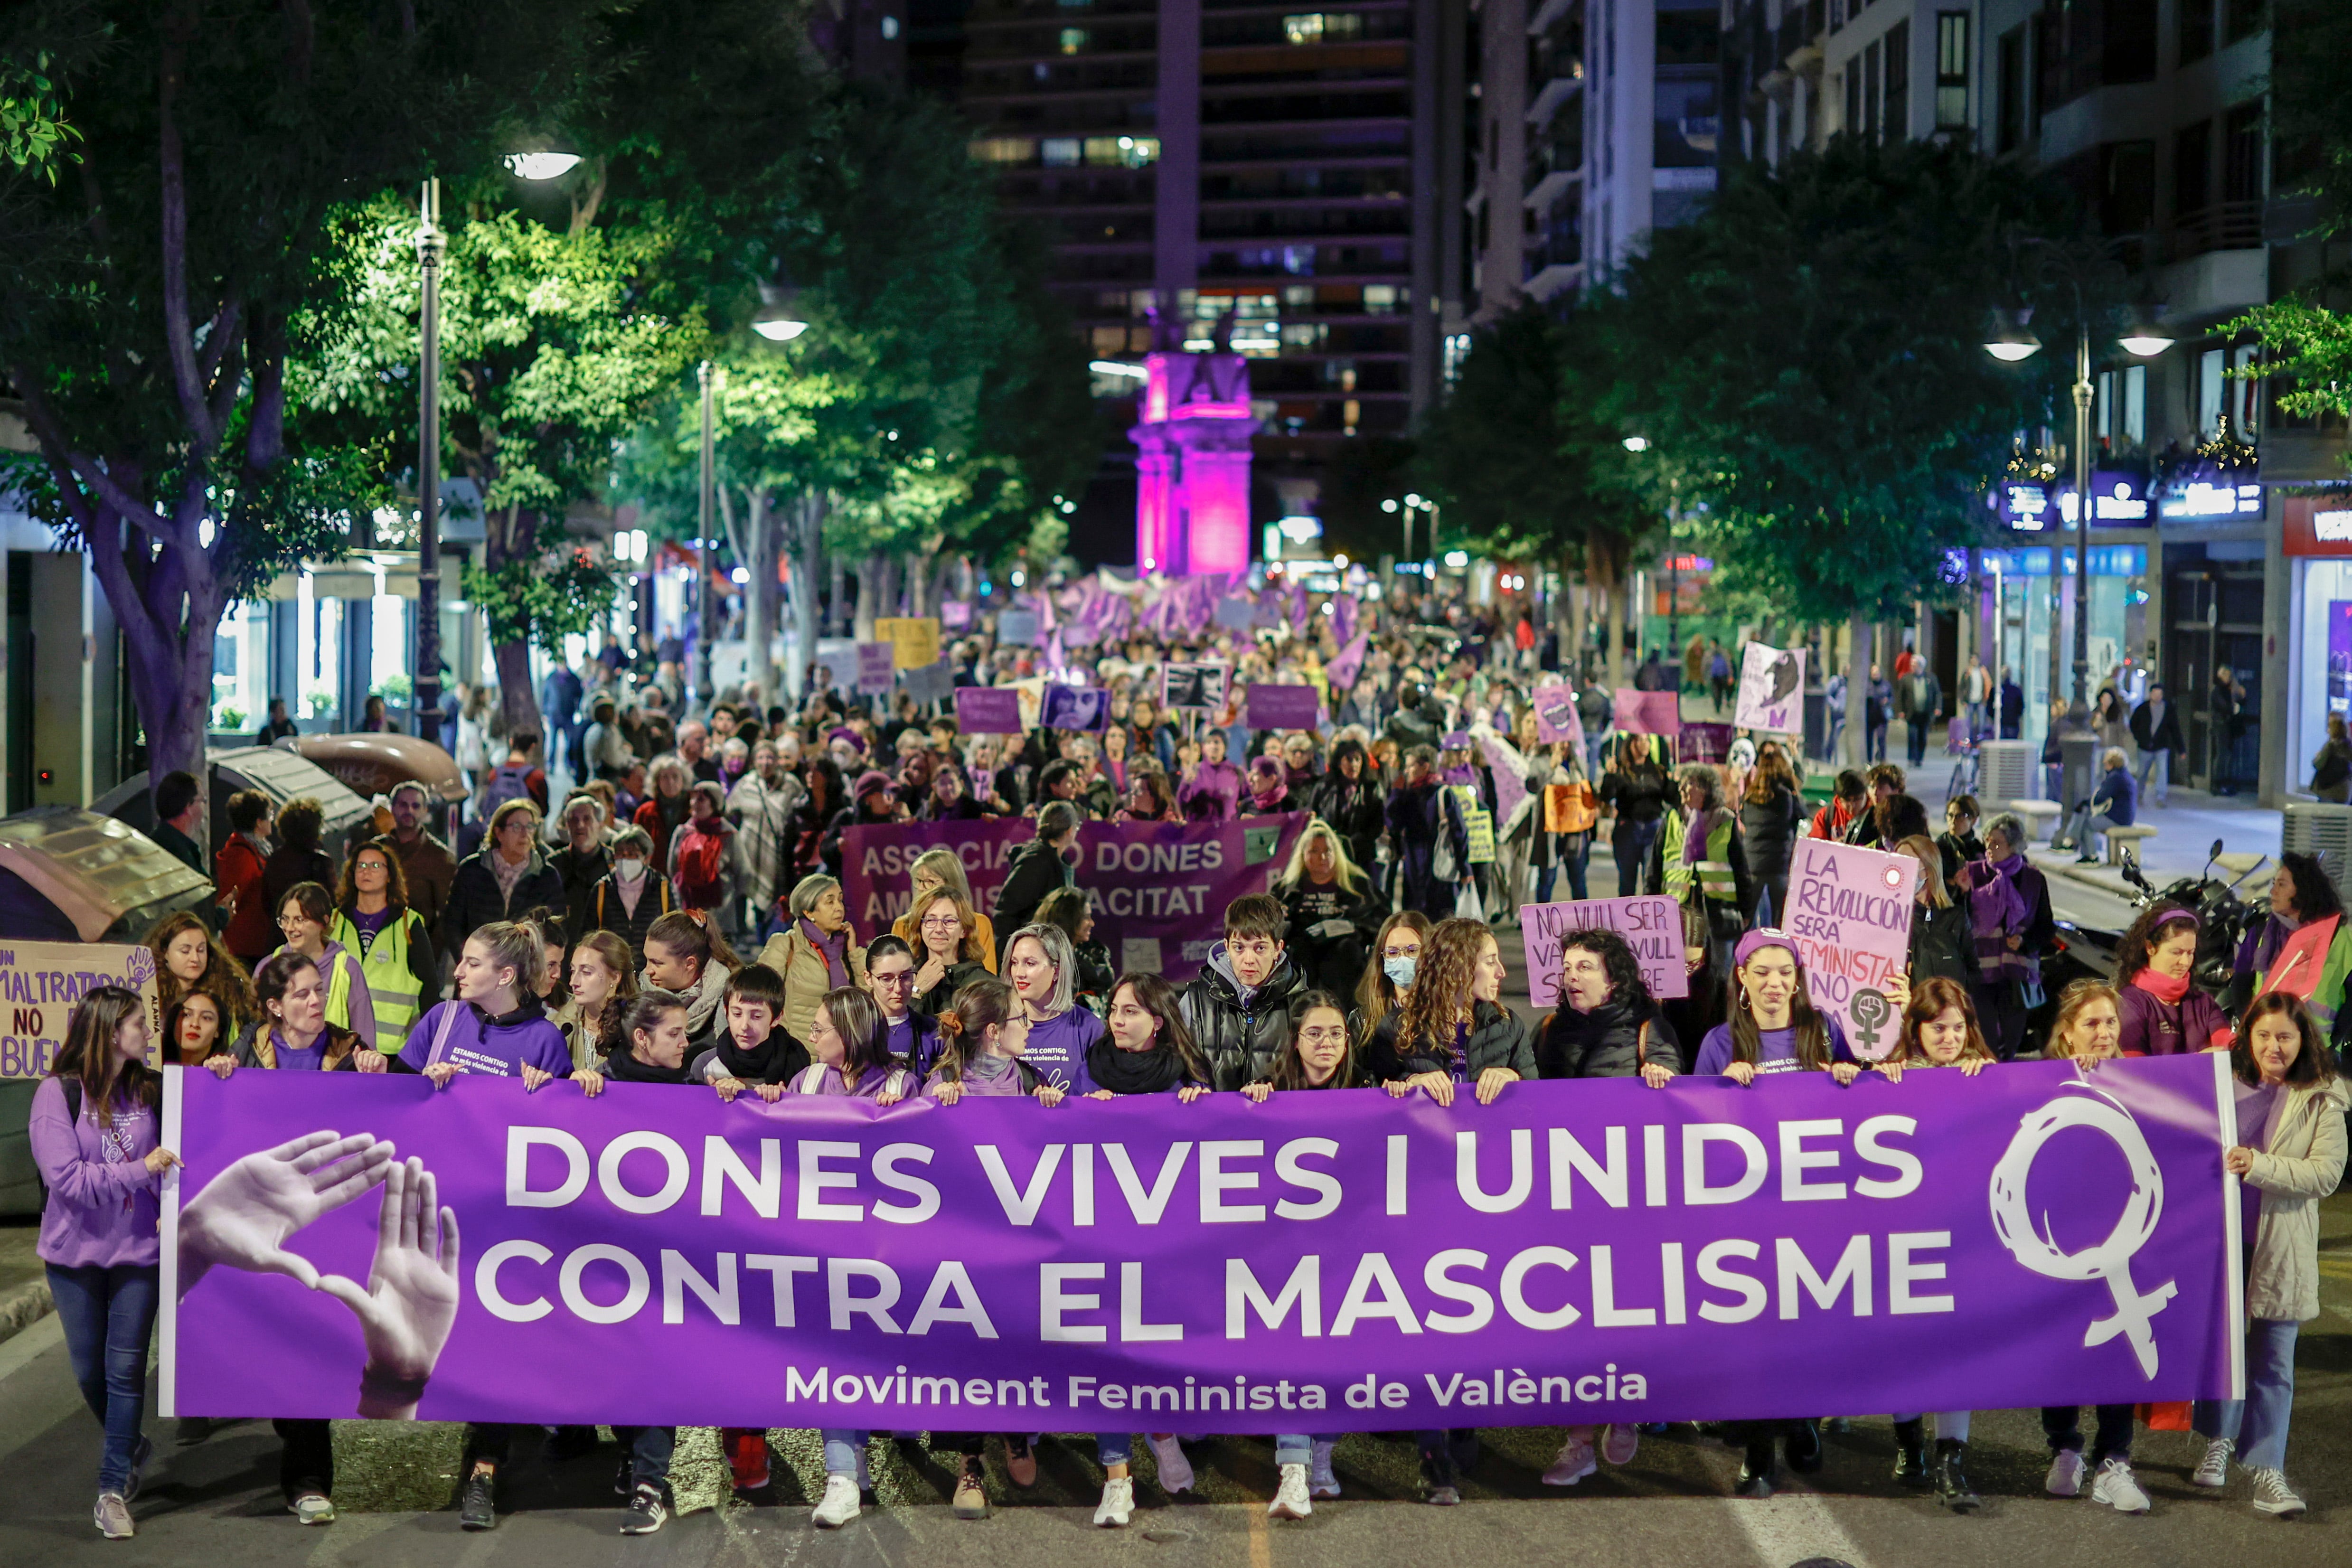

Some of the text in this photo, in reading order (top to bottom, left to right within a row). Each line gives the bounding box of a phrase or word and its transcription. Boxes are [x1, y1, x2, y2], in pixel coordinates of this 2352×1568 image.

[1096, 840, 1223, 873] DONES
[1805, 849, 1839, 882] LA
[1536, 907, 1563, 940] NO
[1625, 901, 1669, 931] SER
[1798, 878, 1910, 933] REVOLUCIÓN
[1793, 914, 1844, 943] SERÁ
[1630, 936, 1676, 960] VULL
[1812, 972, 1849, 1003] NO
[14, 1008, 43, 1037] NO
[452, 1047, 508, 1068] ESTAMOS CONTIGO
[472, 1061, 499, 1074] violencia
[506, 1115, 1923, 1226] DONES VIVES I UNIDES
[475, 1230, 1955, 1343] CONTRA EL MASCLISME
[786, 1363, 1647, 1410] Moviment Feminista de València
